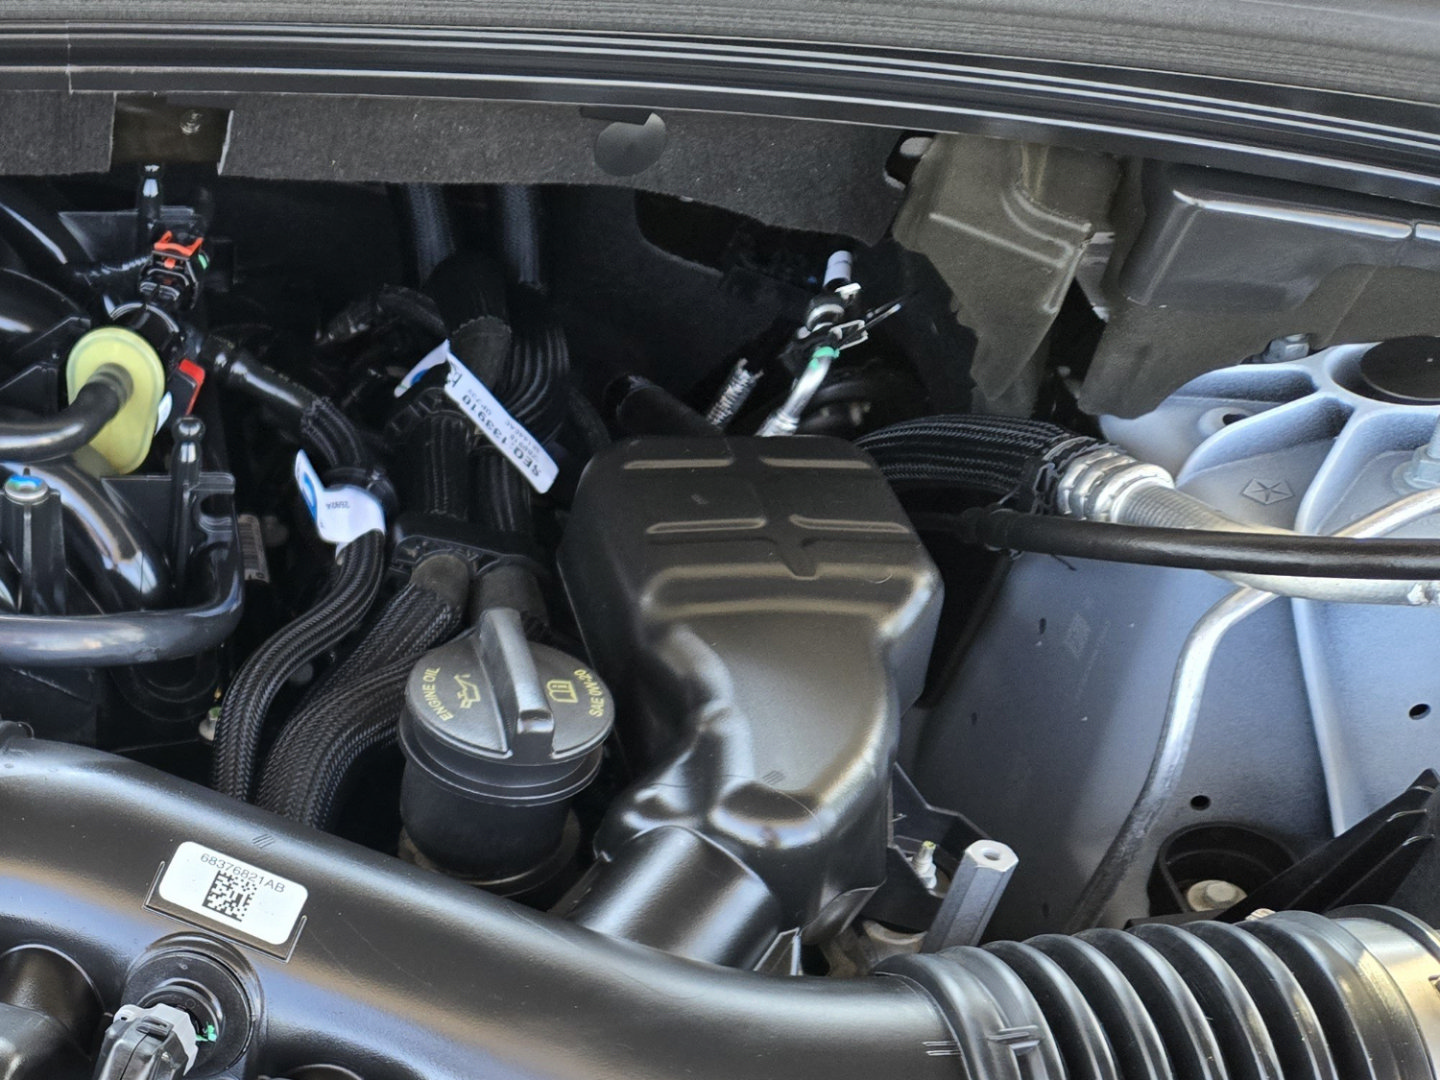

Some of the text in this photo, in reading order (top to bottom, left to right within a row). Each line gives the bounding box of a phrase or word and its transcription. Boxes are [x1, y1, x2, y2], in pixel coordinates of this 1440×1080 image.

[422, 667, 454, 721] ENGINE OIL
[574, 669, 604, 718] SAE 0W-20
[200, 853, 286, 894] 68376821AB
